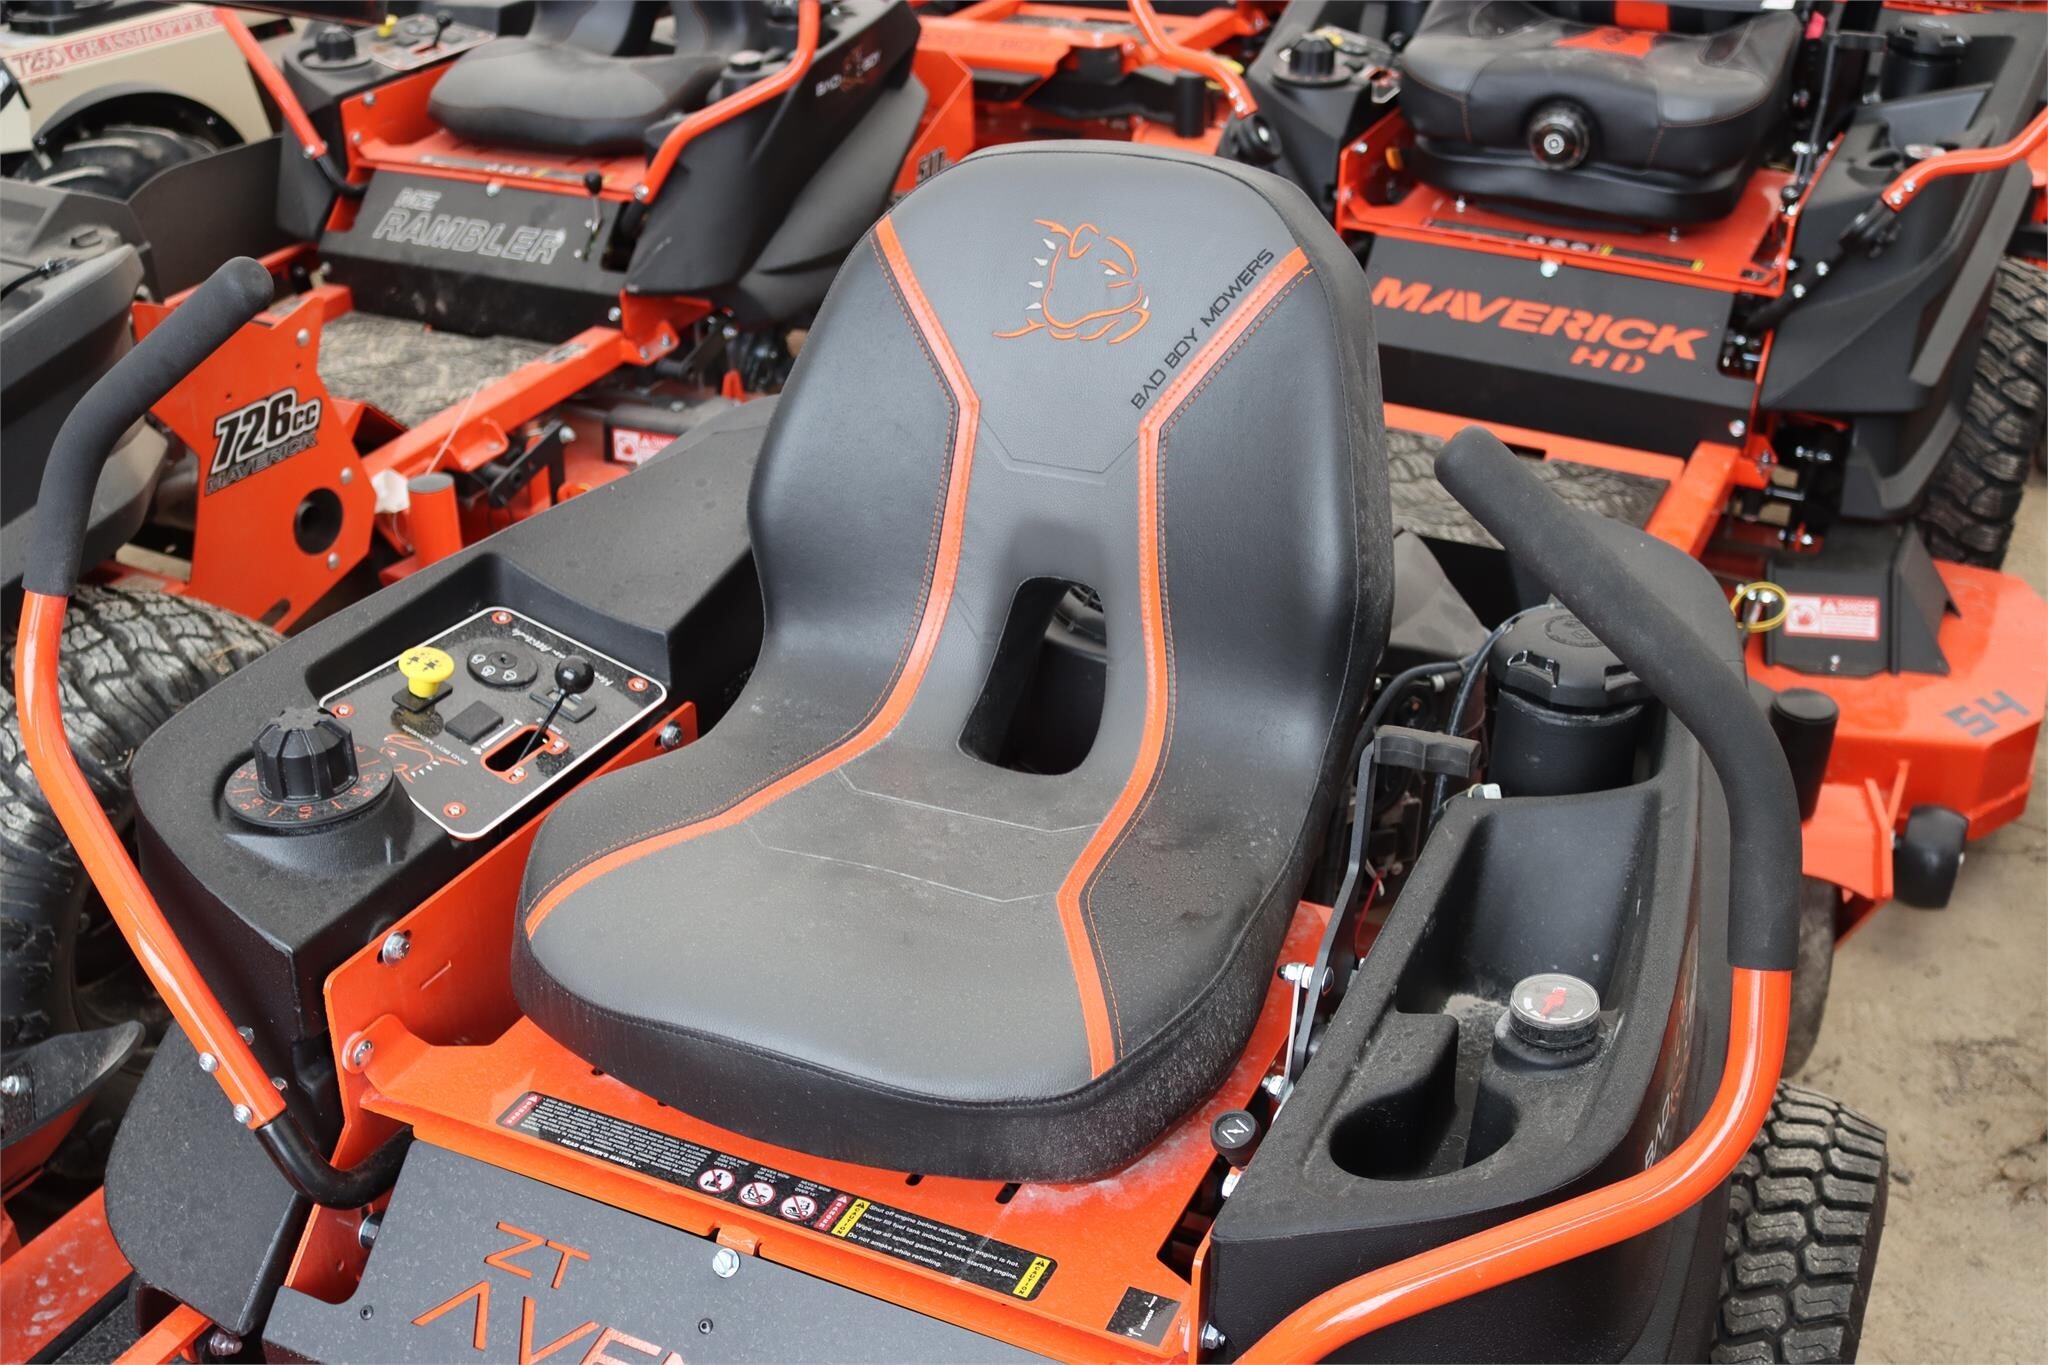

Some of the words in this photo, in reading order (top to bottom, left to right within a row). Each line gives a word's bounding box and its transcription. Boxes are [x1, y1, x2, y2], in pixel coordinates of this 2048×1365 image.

[816, 74, 842, 97] BAD
[372, 206, 567, 265] RAMBLER
[1131, 368, 1166, 410] BAD
[1164, 327, 1198, 369] BOY
[1200, 248, 1275, 328] MOWERS
[1371, 276, 1709, 361] MAVERICK
[1570, 345, 1646, 374] HD
[212, 388, 321, 474] 726cc
[1943, 690, 2030, 738] 54
[561, 1139, 579, 1148] READ
[579, 1145, 609, 1157] OWNER'S
[608, 1155, 637, 1166] MANUAL
[1644, 1092, 1671, 1171] BAD
[837, 1208, 860, 1234] CAUTION
[863, 1213, 882, 1222] Never
[906, 1227, 921, 1235] tank
[921, 1232, 946, 1243] indoors
[957, 1243, 974, 1252] when
[976, 1250, 998, 1260] engine
[869, 1205, 884, 1214] Shut
[895, 1214, 916, 1224] engine
[916, 1220, 938, 1230] before
[484, 1221, 592, 1290] ZT
[856, 1223, 872, 1232] Wipe
[892, 1235, 914, 1245] spilled
[914, 1242, 942, 1255] gasoline
[944, 1252, 966, 1262] before
[967, 1259, 993, 1272] starting
[871, 1240, 892, 1250] smoke
[894, 1248, 911, 1256] while
[1019, 1266, 1040, 1294] CAUTION
[411, 1280, 685, 1365] AVE
